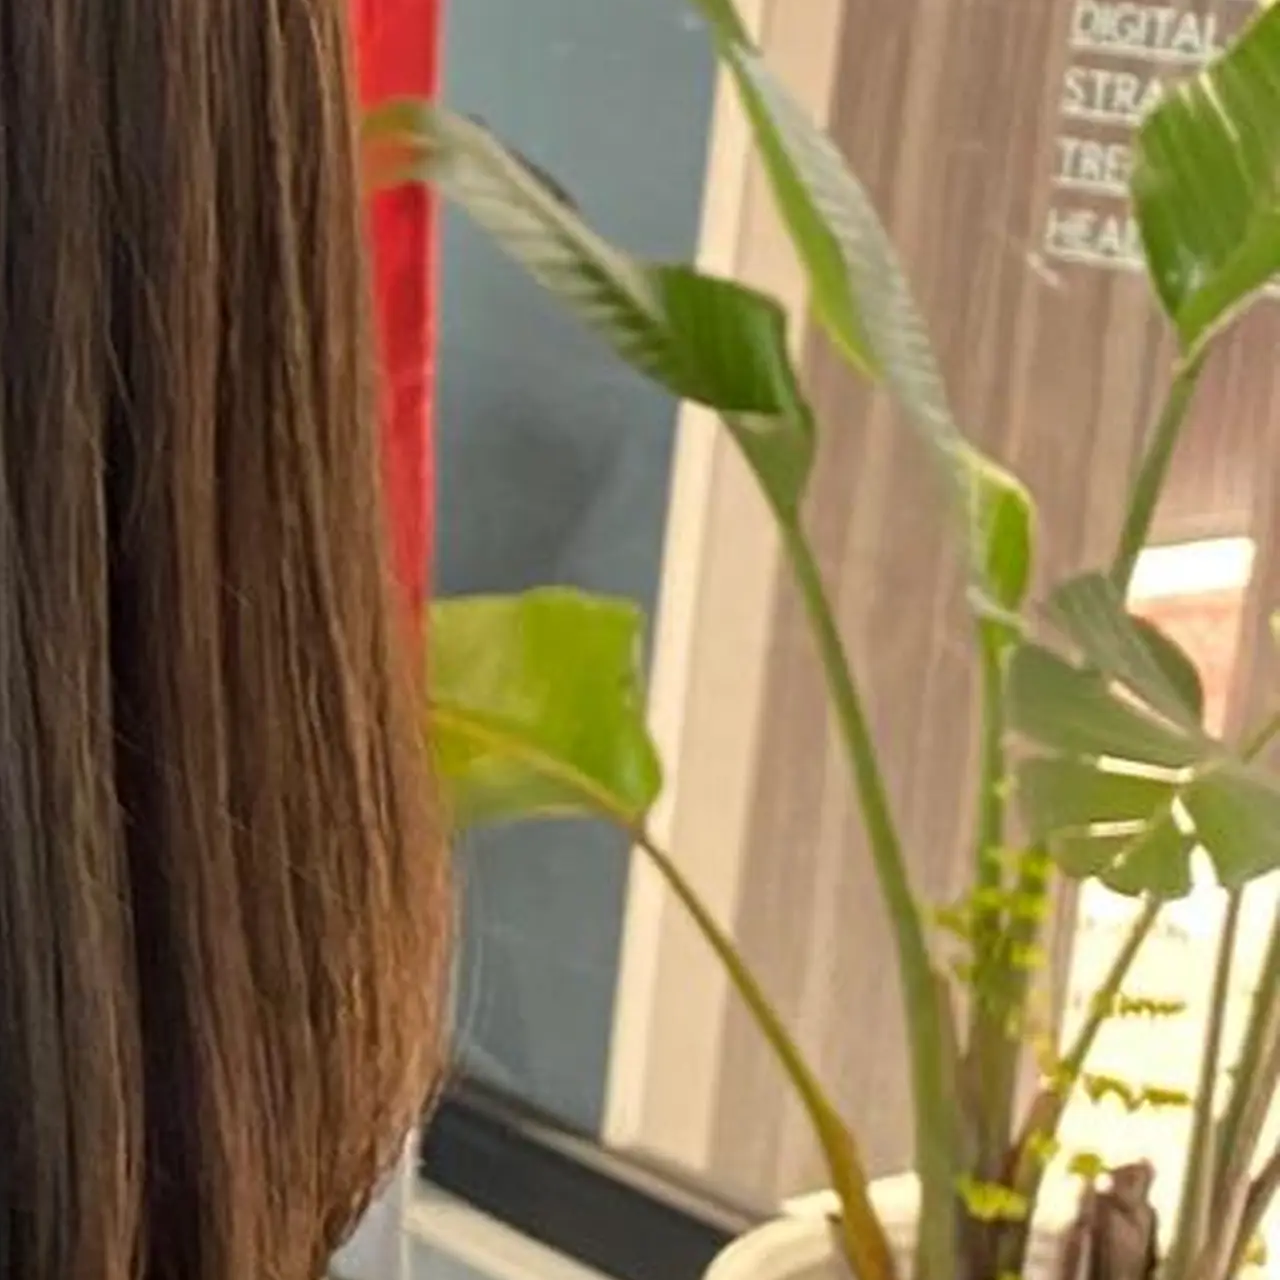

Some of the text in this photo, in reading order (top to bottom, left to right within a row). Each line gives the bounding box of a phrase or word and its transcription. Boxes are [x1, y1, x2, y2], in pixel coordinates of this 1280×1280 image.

[1061, 66, 1162, 118] STRA
[1056, 136, 1133, 182] TRE
[1045, 207, 1142, 258] HEA
